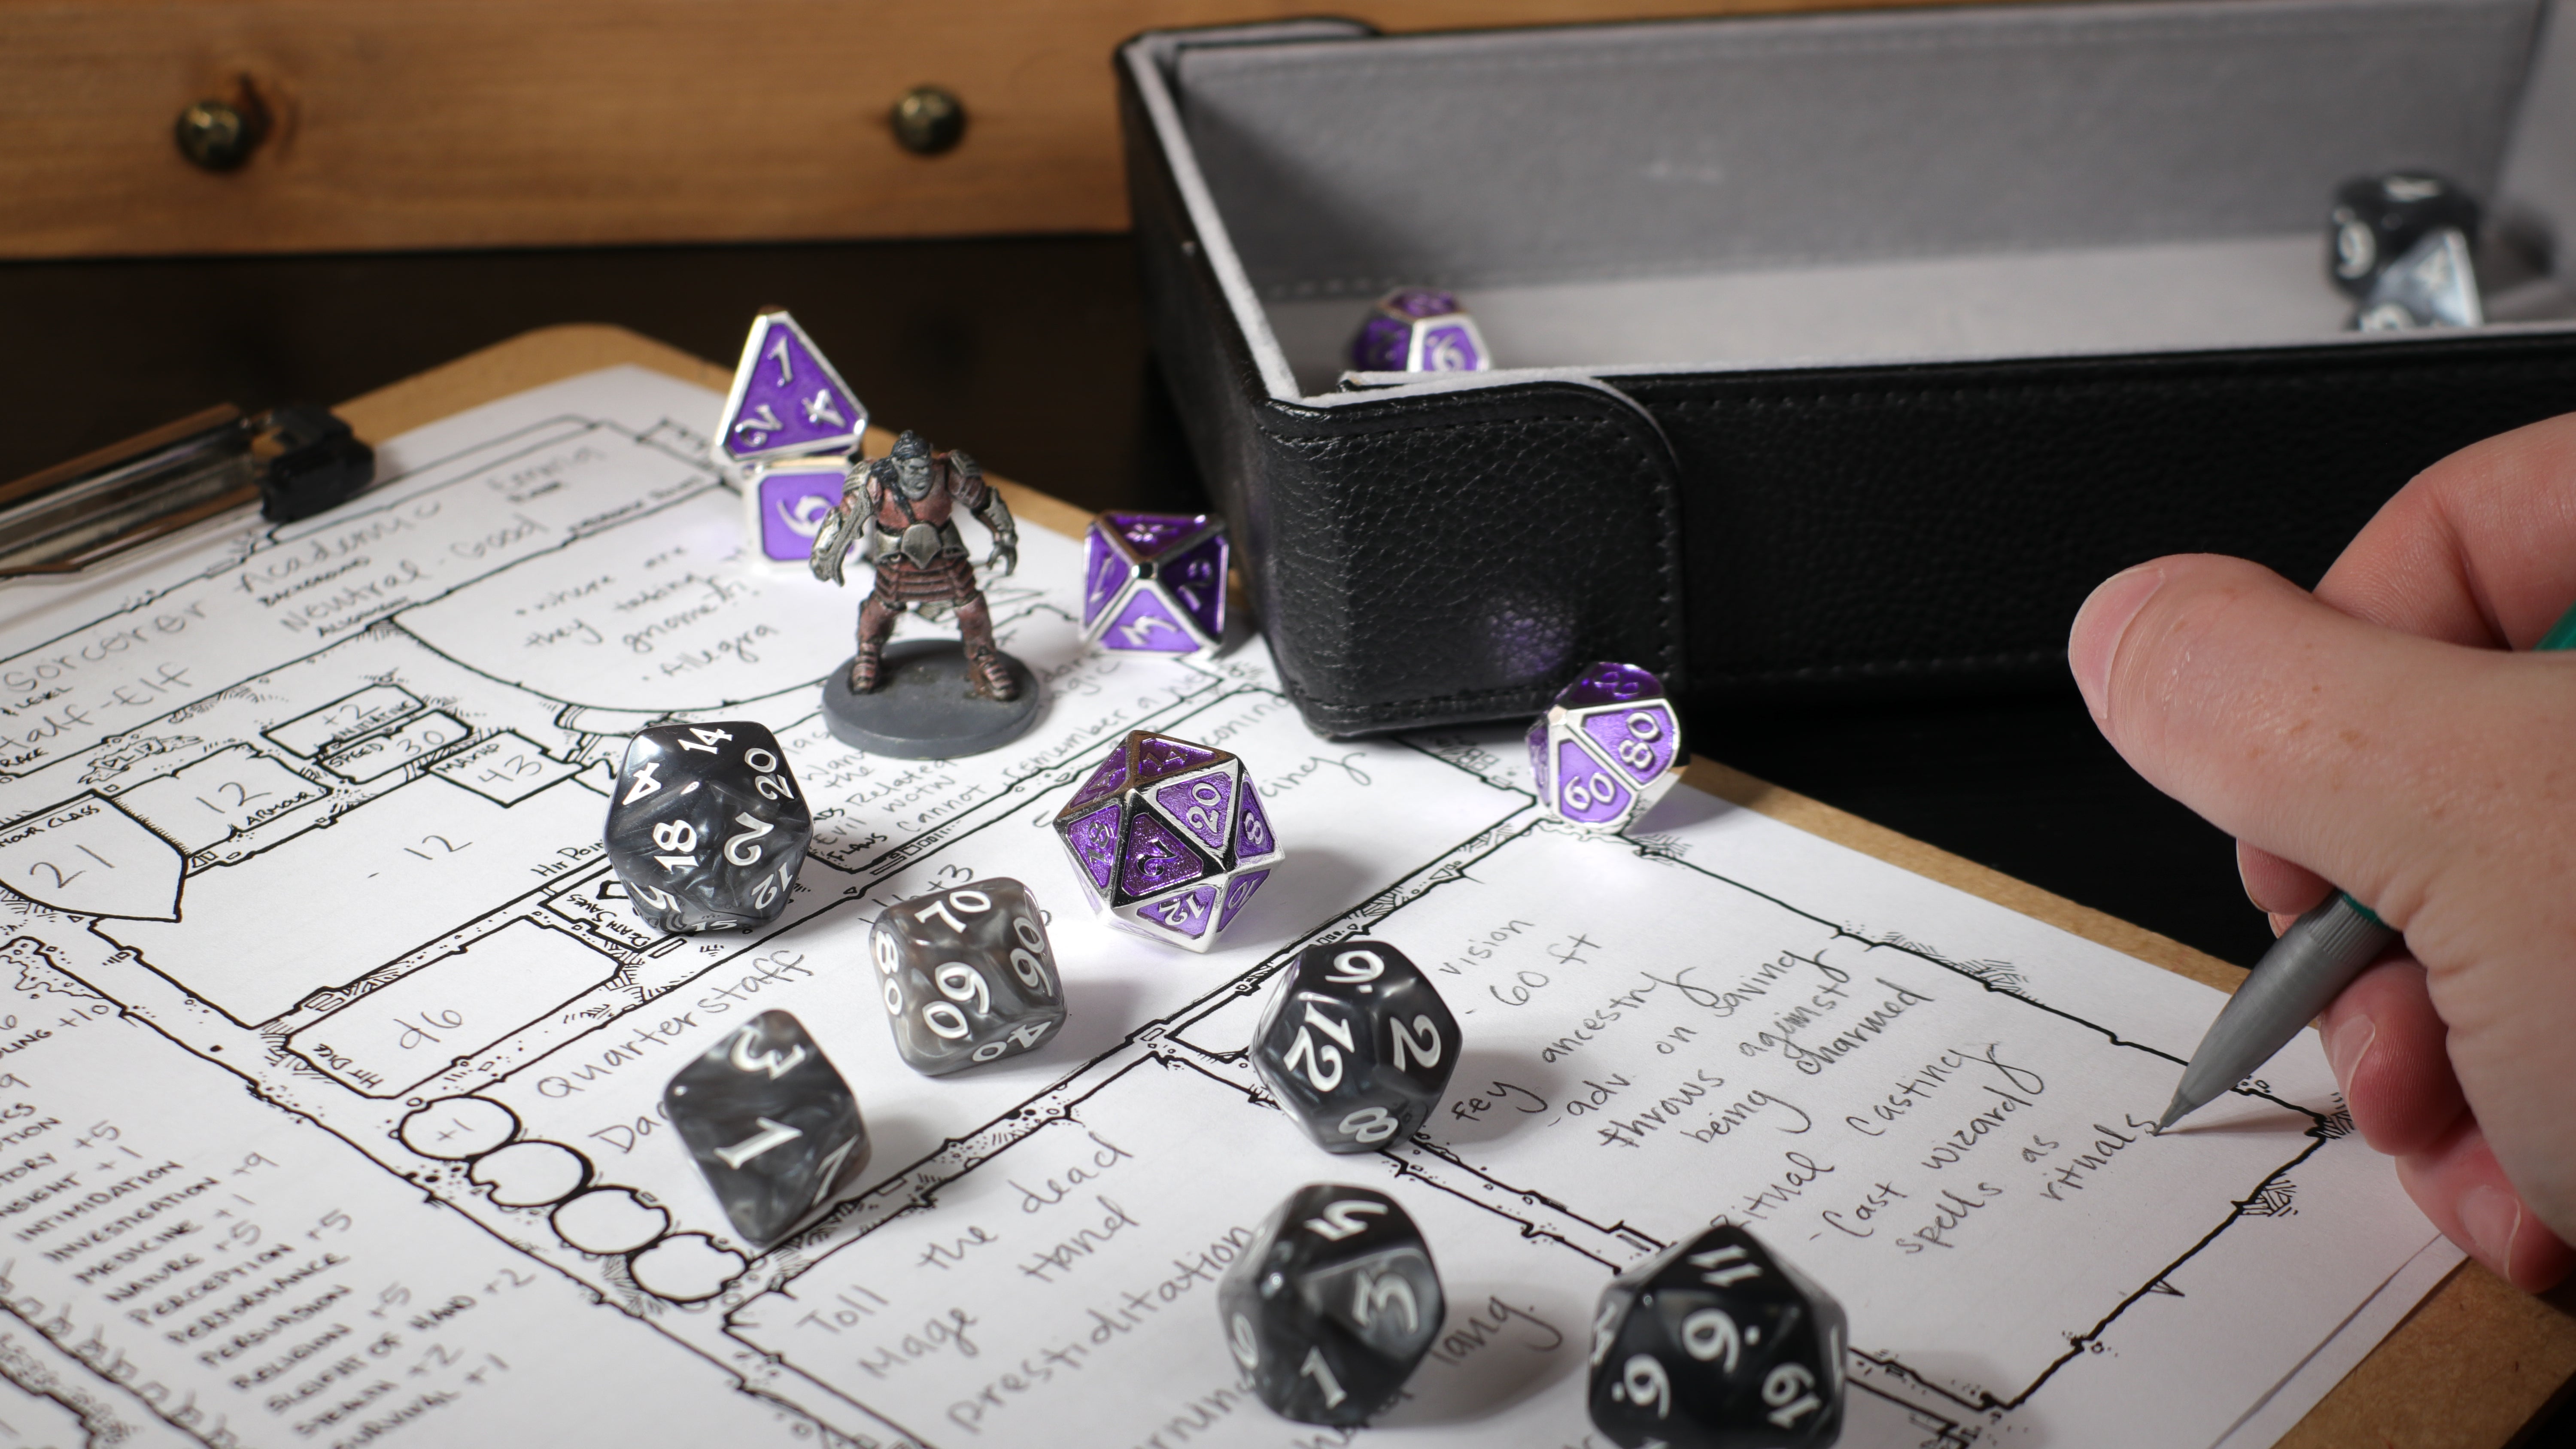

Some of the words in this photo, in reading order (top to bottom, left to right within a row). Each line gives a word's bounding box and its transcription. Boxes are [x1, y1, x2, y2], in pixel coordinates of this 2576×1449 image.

[767, 335, 793, 387] 1
[735, 404, 783, 447] 2
[802, 389, 846, 428] 4
[329, 738, 384, 768] SPEED
[396, 731, 445, 756] 30
[678, 727, 733, 754] 14
[1618, 712, 1661, 769] 80
[479, 756, 542, 783] 43
[622, 762, 661, 806] 4
[744, 748, 795, 800] 20
[1564, 772, 1616, 811] 60
[48, 805, 100, 828] CLASS
[196, 781, 272, 814] 12
[246, 790, 312, 826] ARMOUR
[1188, 782, 1221, 834] 20
[404, 835, 472, 860] 12
[652, 820, 700, 872] 18
[723, 812, 775, 866] 2
[1245, 812, 1263, 845] 8
[30, 844, 115, 888] 21
[1136, 839, 1178, 877] 2
[566, 893, 617, 920] SAVES
[751, 866, 793, 910] 12
[1159, 893, 1205, 926] 12
[606, 919, 651, 947] DEATH
[691, 920, 737, 932] 15
[914, 890, 991, 933] 70
[1439, 917, 1534, 975] vision
[875, 930, 903, 1015] 80
[1489, 971, 1549, 1006] 60
[58, 1004, 109, 1027] +10
[1656, 1025, 1698, 1054] on
[1713, 949, 1851, 1018] saving
[394, 1010, 462, 1049] d6
[972, 1021, 1052, 1063] 40
[1283, 1001, 1355, 1091] 12
[1389, 1014, 1442, 1072] 2
[1451, 1080, 1548, 1122] fey
[1541, 967, 1721, 1063] ancestry
[314, 1045, 352, 1071] DICE
[730, 1025, 806, 1080] 3
[1680, 1090, 1812, 1144] being
[1796, 977, 1935, 1075] charmed
[350, 1069, 384, 1088] HIT
[437, 1119, 474, 1141] +1
[1338, 1106, 1399, 1143] 8
[1597, 1069, 1725, 1148] throws
[74, 1120, 121, 1148] +5
[714, 1117, 803, 1170] 1
[1822, 1181, 1907, 1238] Cast
[1921, 1085, 2033, 1171] wizard
[2040, 1113, 2157, 1202] rituals
[14, 1160, 184, 1243] INTIMIDATION
[1895, 1181, 2003, 1253] spells
[2021, 1134, 2059, 1163] as
[42, 1176, 221, 1264] INVESTIGATION
[794, 1284, 888, 1335] Toll
[916, 1226, 998, 1270] the
[1006, 1130, 1134, 1215] dead
[1303, 1200, 1388, 1241] 5
[73, 1220, 204, 1285] MEDICINE
[1686, 1244, 1763, 1288] 11
[103, 1252, 204, 1304] NATURE
[125, 1242, 296, 1328] PERCEPTION
[164, 1251, 351, 1347] PERFORMANCE
[1351, 1268, 1419, 1335] 3
[197, 1284, 353, 1369] PERSUASION
[230, 1323, 353, 1391] RELIGION
[1300, 1345, 1347, 1410] 1
[264, 1353, 368, 1413] SLEIGHT
